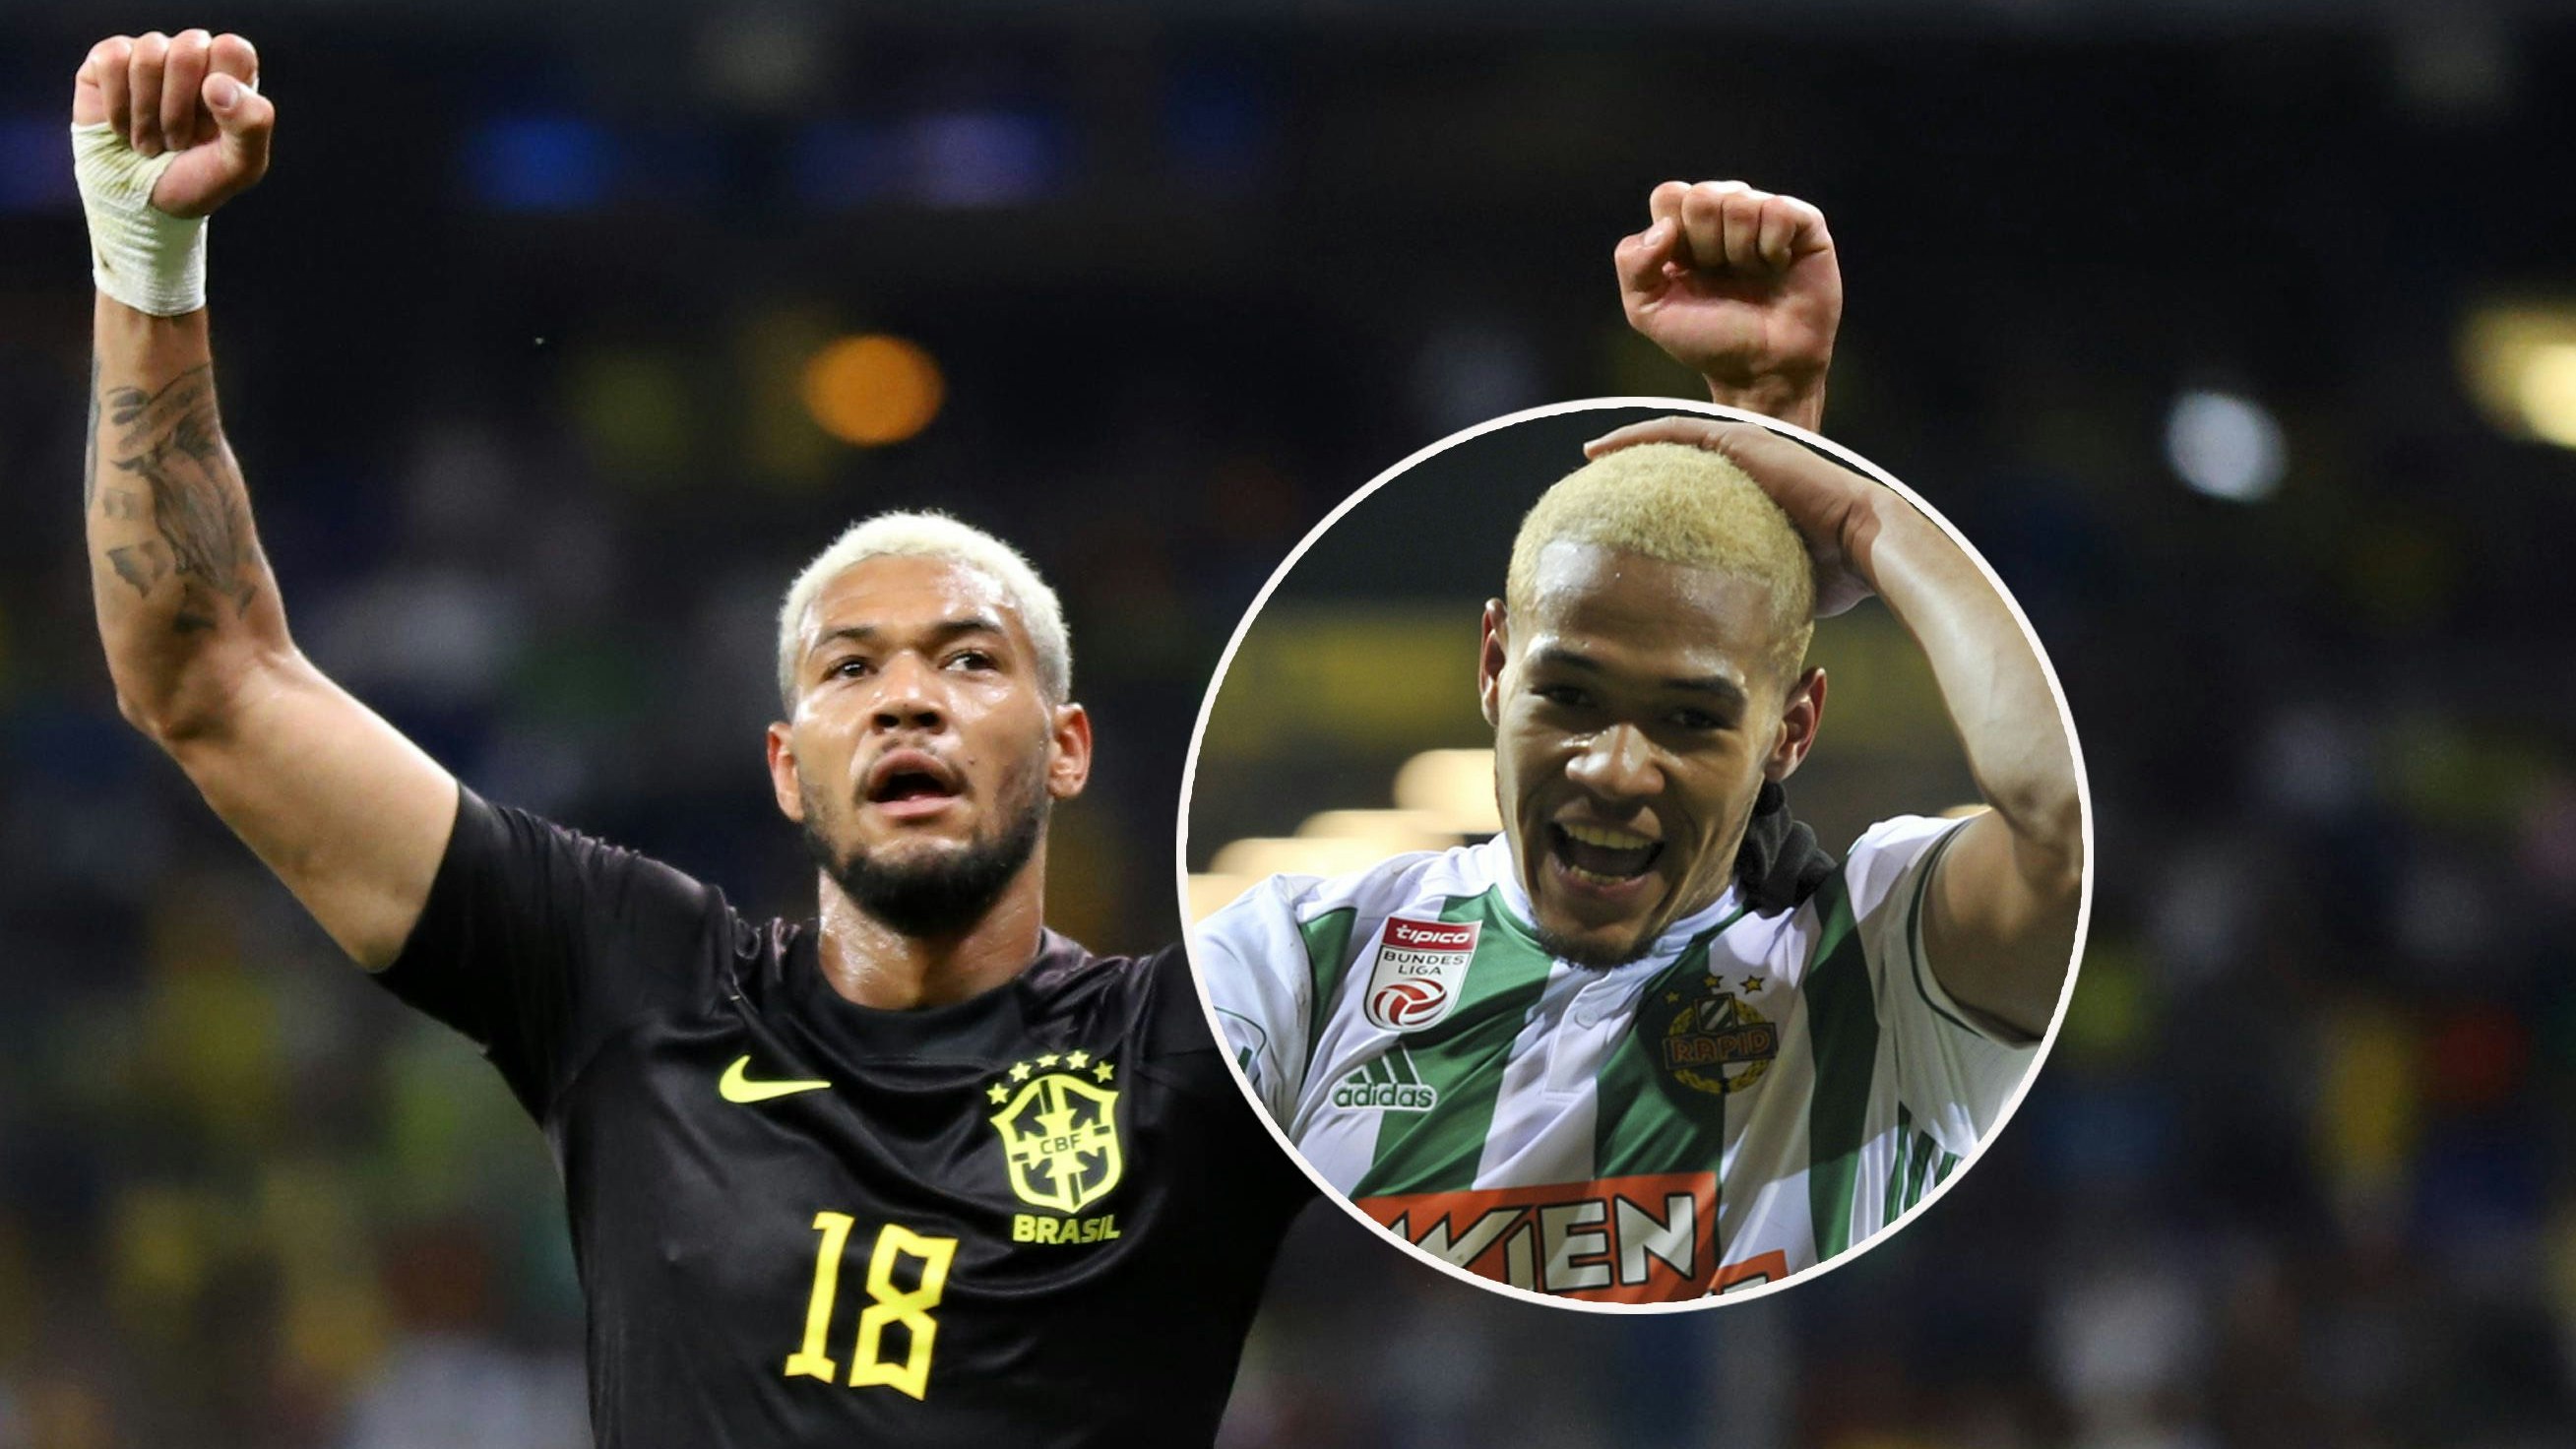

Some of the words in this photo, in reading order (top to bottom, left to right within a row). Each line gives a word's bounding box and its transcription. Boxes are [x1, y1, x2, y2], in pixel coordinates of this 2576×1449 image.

[1396, 924, 1470, 944] tipico
[1383, 950, 1464, 966] BUNDES
[1398, 965, 1442, 976] LIGA
[1672, 1031, 1770, 1063] RAPID
[1333, 1084, 1433, 1107] adidas
[1039, 1133, 1082, 1156] CBF
[1012, 1214, 1121, 1244] BRASIL
[1387, 1192, 1698, 1293] WIEN
[785, 1211, 959, 1402] 18
